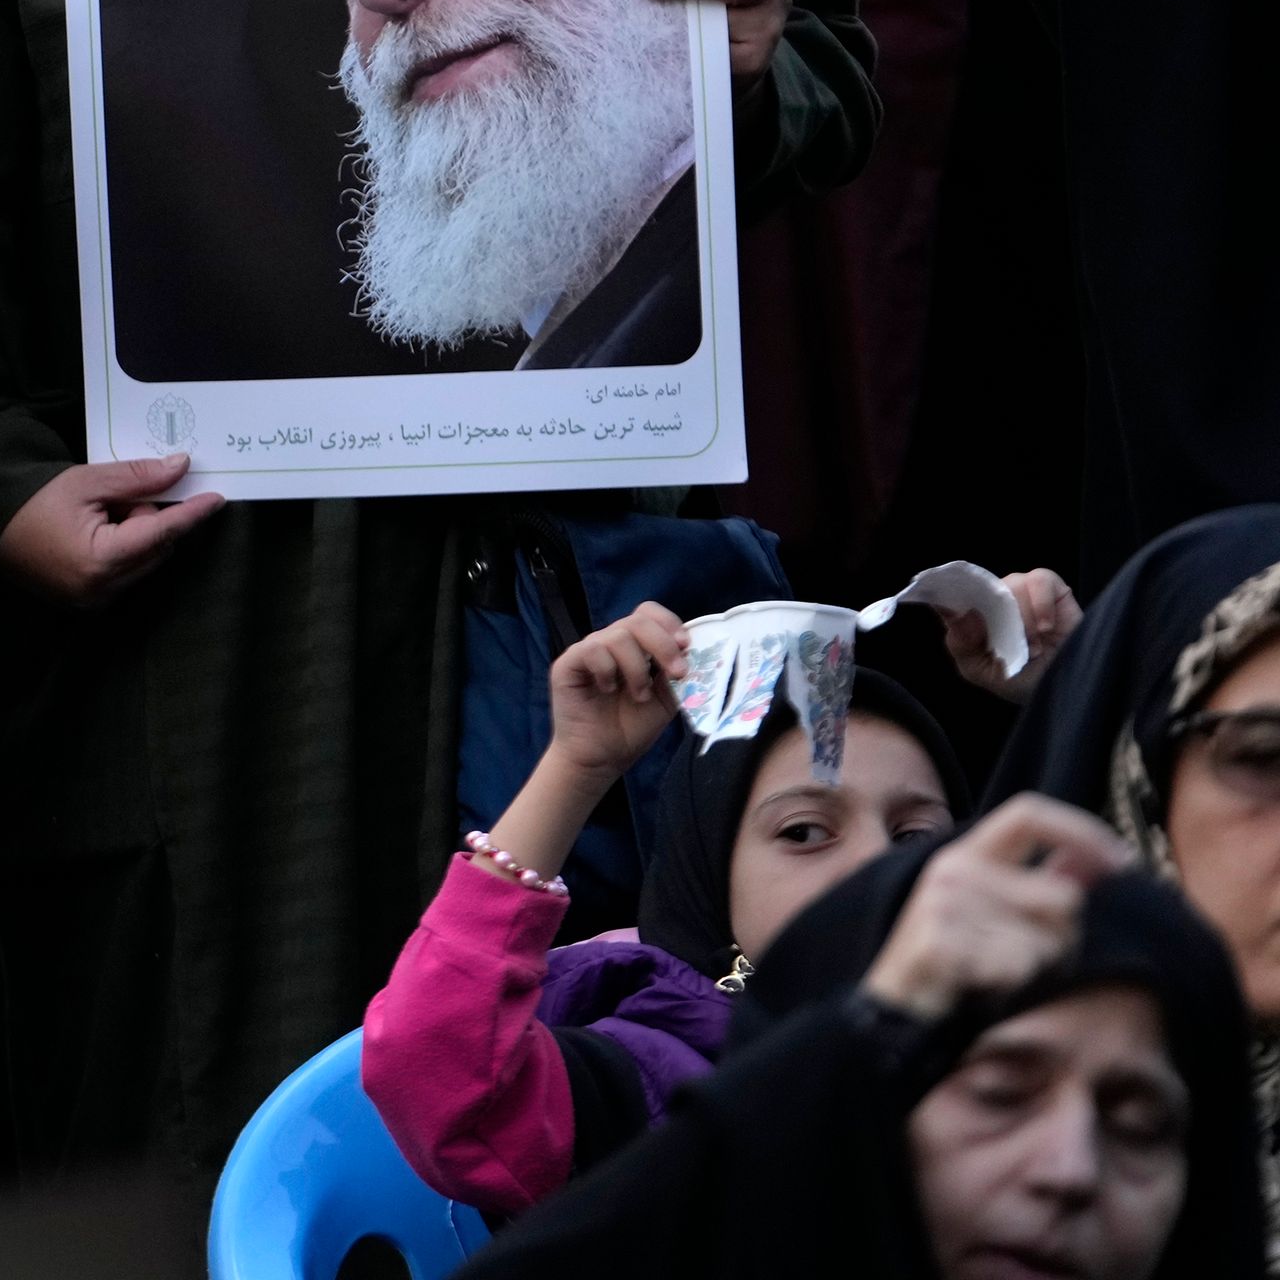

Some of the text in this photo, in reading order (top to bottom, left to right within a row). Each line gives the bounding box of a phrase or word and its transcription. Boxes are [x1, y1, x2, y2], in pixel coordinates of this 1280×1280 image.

[585, 382, 681, 405] امام خامنه ای:
[399, 423, 432, 447] انبیا
[437, 422, 511, 446] معجزات
[515, 423, 534, 443] به
[539, 417, 586, 437] حادثه
[593, 416, 636, 441] ترین
[642, 411, 683, 438] شبیه
[225, 432, 253, 453] بود
[258, 427, 314, 451] انقلاب
[320, 431, 382, 451] پیروزی
